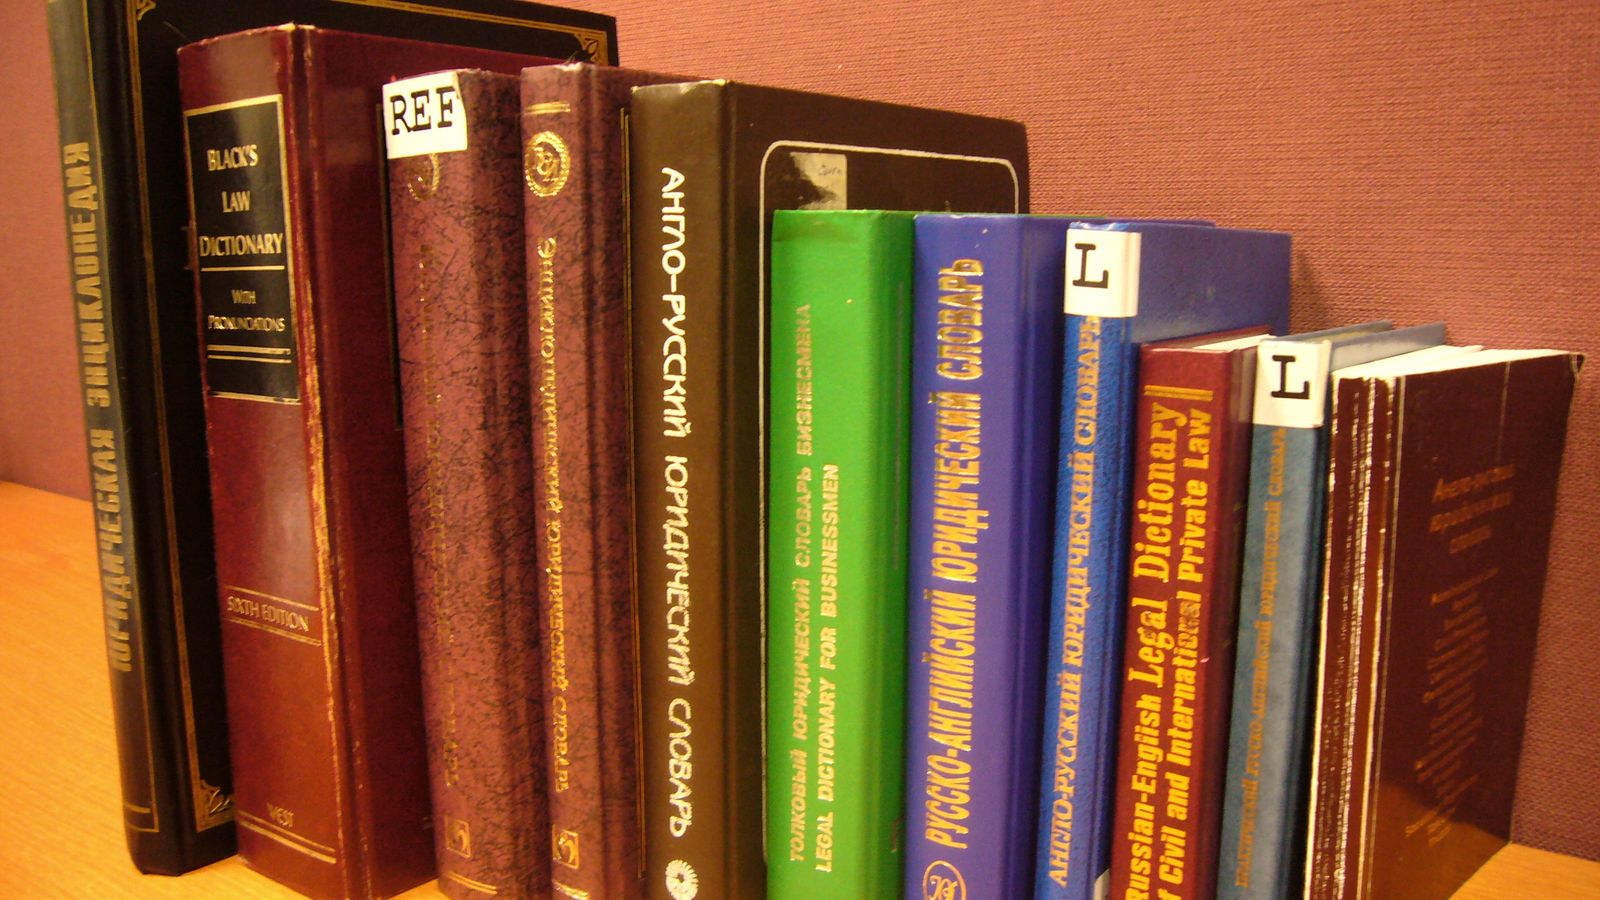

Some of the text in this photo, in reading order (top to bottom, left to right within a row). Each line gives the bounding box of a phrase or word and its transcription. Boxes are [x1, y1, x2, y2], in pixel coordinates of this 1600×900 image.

[207, 144, 259, 172] BLACK'S
[390, 85, 456, 136] REF
[199, 232, 284, 257] DICTIONARY
[222, 190, 250, 213] LAW
[1072, 242, 1109, 289] L
[936, 258, 985, 381] СЛОВАРЬ
[63, 142, 133, 673] ЮРИДИЧЕСКАЯ ЭНЦИКЛОПЕДИЯ
[1270, 354, 1310, 400] L
[926, 391, 990, 584] ЮРИДИЧЕСКИЙ
[1182, 407, 1213, 470] Law
[661, 167, 696, 838] АНГЛО-РУССКИЙ ЮРИДИЧЕСКИЙ СЛОВАРЬ
[1132, 402, 1188, 584] Dictionary
[1176, 479, 1209, 583] Private
[227, 596, 309, 633] SIXTH EDITION
[789, 303, 814, 862] ТОЛКОВЫЙ ЮРИДИЧЕСКИЙ СЛОВАРЬ БИЗНЕСМЕНА
[1047, 315, 1101, 888] АНГЛО-РУССКИЙ ЮРИДИЧЕСКИЙ СЛОВАРЬ
[815, 463, 839, 873] LEGAL DICTIONARY FOR BUSINESSMEN
[1127, 596, 1175, 689] Legal
[1166, 590, 1203, 768] International
[921, 588, 978, 850] РУССКО-АНГЛИЙСКИЙ
[1165, 771, 1190, 821] and
[1158, 825, 1187, 885] Civil
